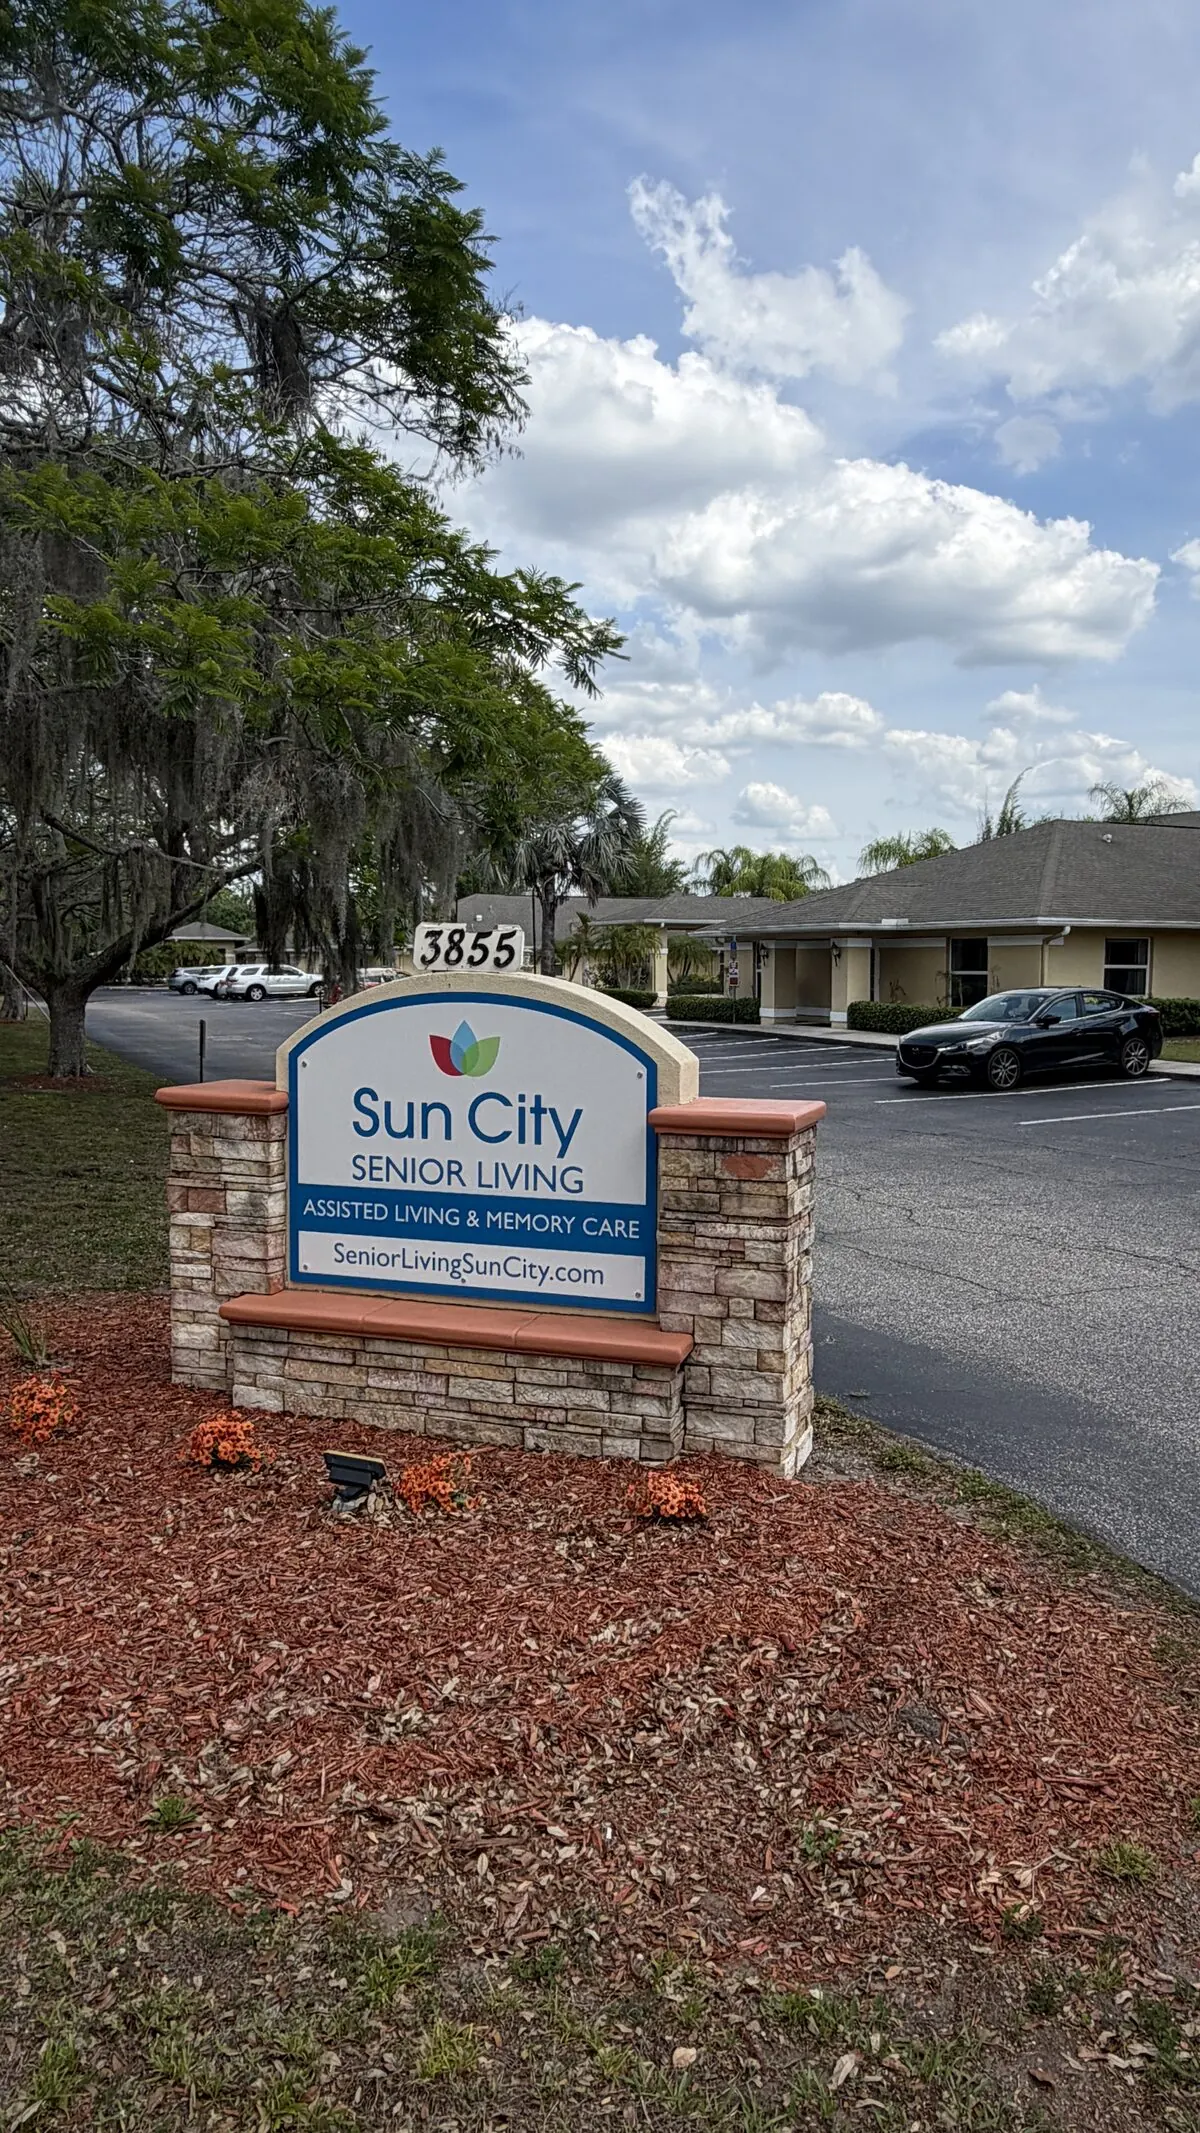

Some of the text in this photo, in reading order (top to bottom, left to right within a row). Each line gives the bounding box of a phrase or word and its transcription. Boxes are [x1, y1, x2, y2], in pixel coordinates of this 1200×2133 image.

[420, 929, 517, 968] 3855
[352, 1087, 583, 1158] Sun City
[351, 1155, 584, 1193] SENIOR LIVING
[303, 1199, 640, 1239] ASSISTED LIVING & MEMORY CARE
[333, 1243, 604, 1286] SeniorLivingSunCity.com
